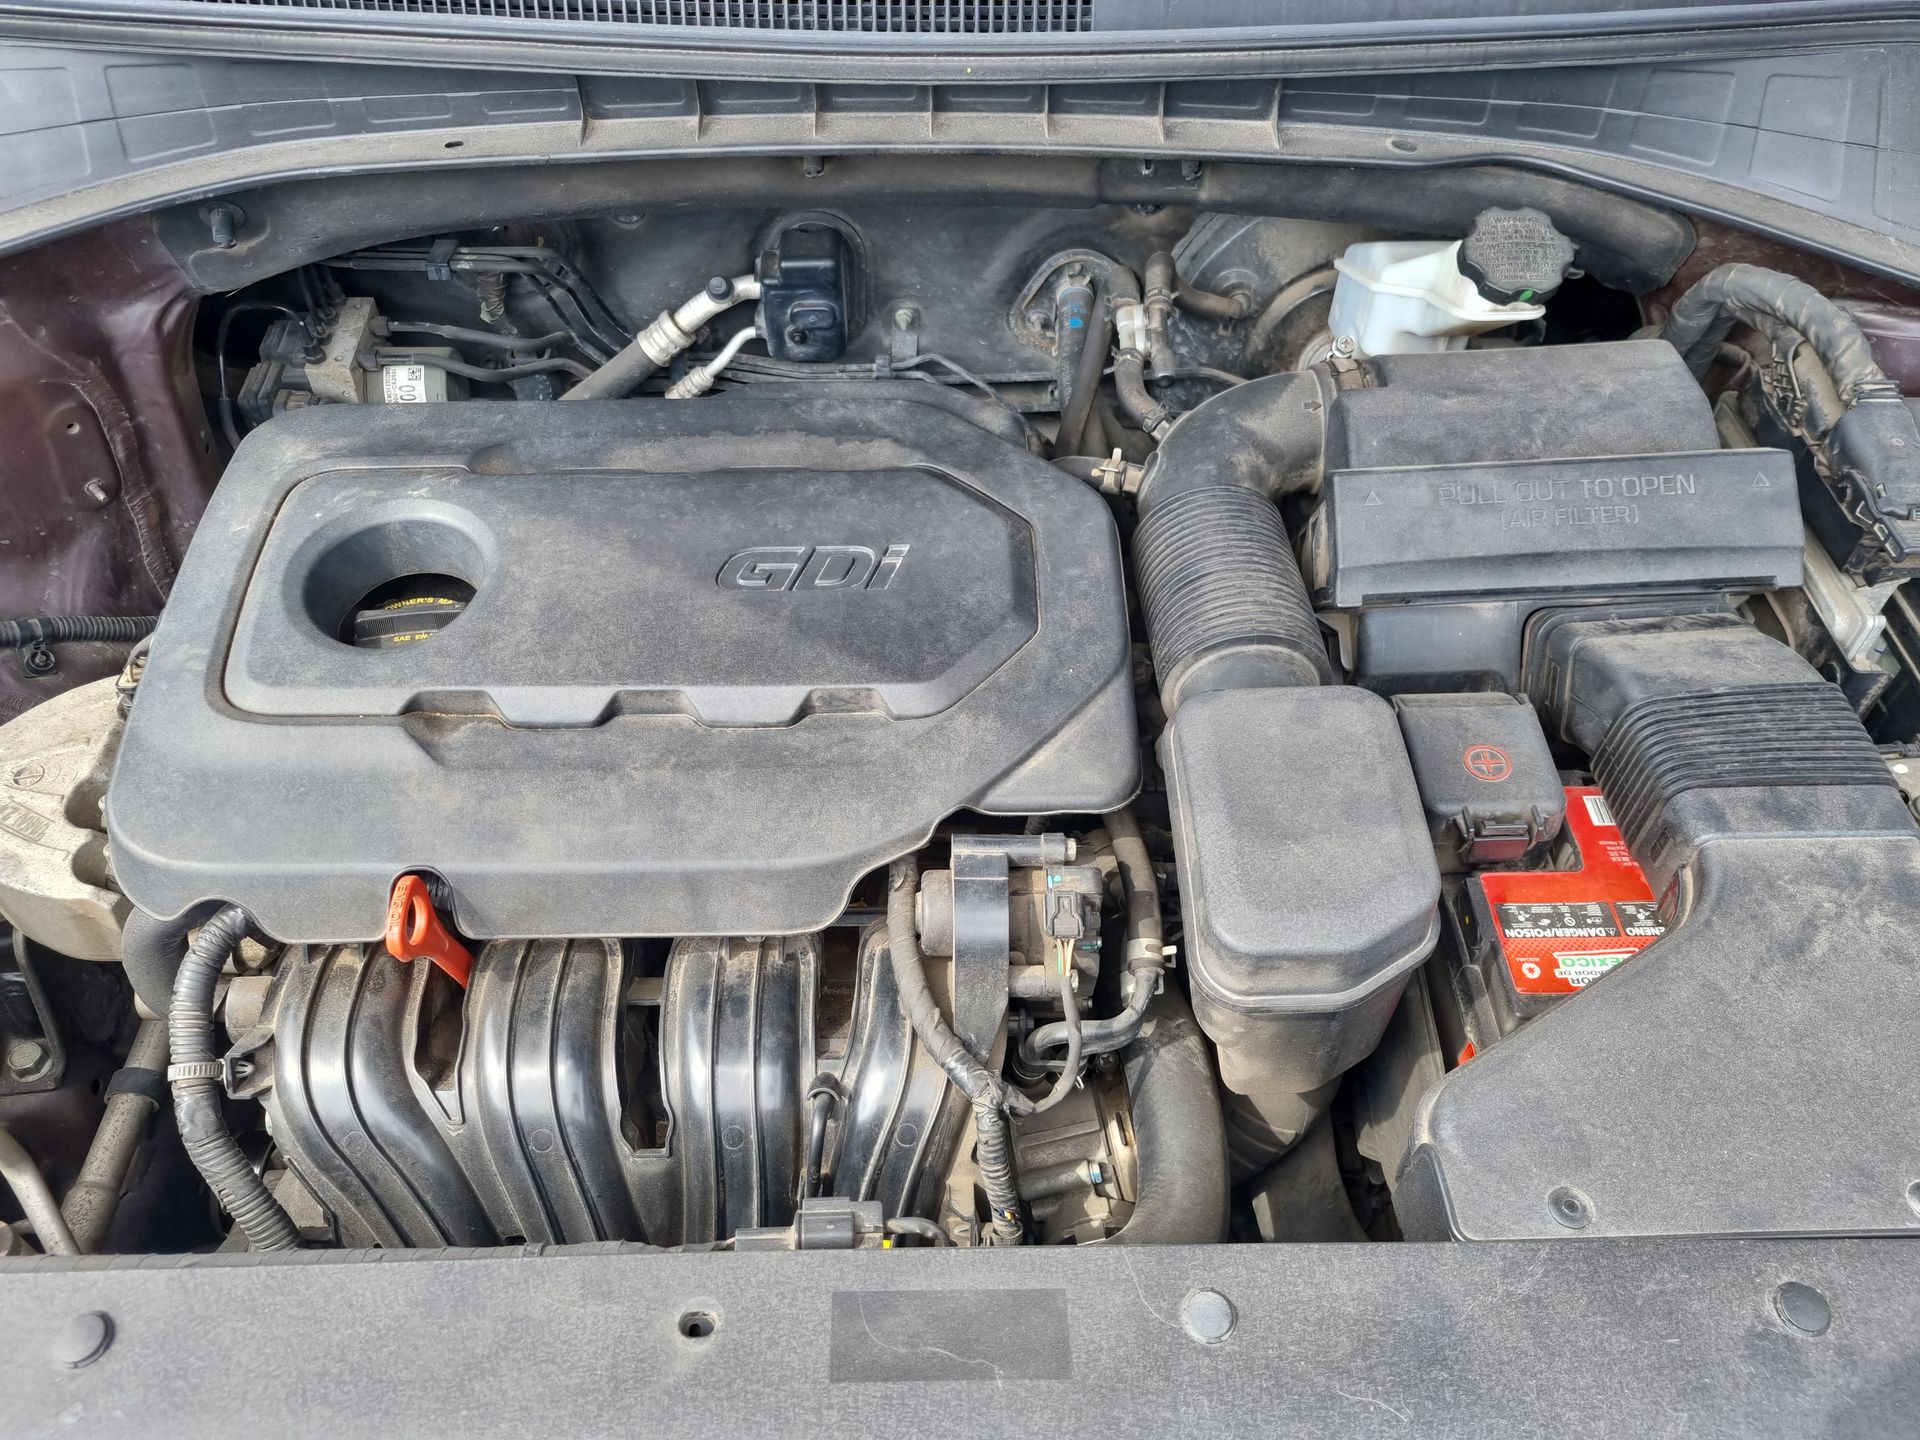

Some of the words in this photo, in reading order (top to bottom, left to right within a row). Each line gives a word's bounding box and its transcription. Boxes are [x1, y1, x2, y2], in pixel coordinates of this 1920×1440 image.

[1438, 483, 1506, 506] PULL
[1515, 479, 1570, 503] OUT
[1580, 478, 1614, 499] TO
[1621, 473, 1696, 497] OPEN
[385, 597, 434, 610] OWNER'S
[393, 634, 411, 642] SAE
[389, 913, 401, 931] OIL
[1505, 927, 1606, 938] DANGER/POISON
[1561, 957, 1624, 967] EXICO
[1571, 976, 1593, 985] OR
